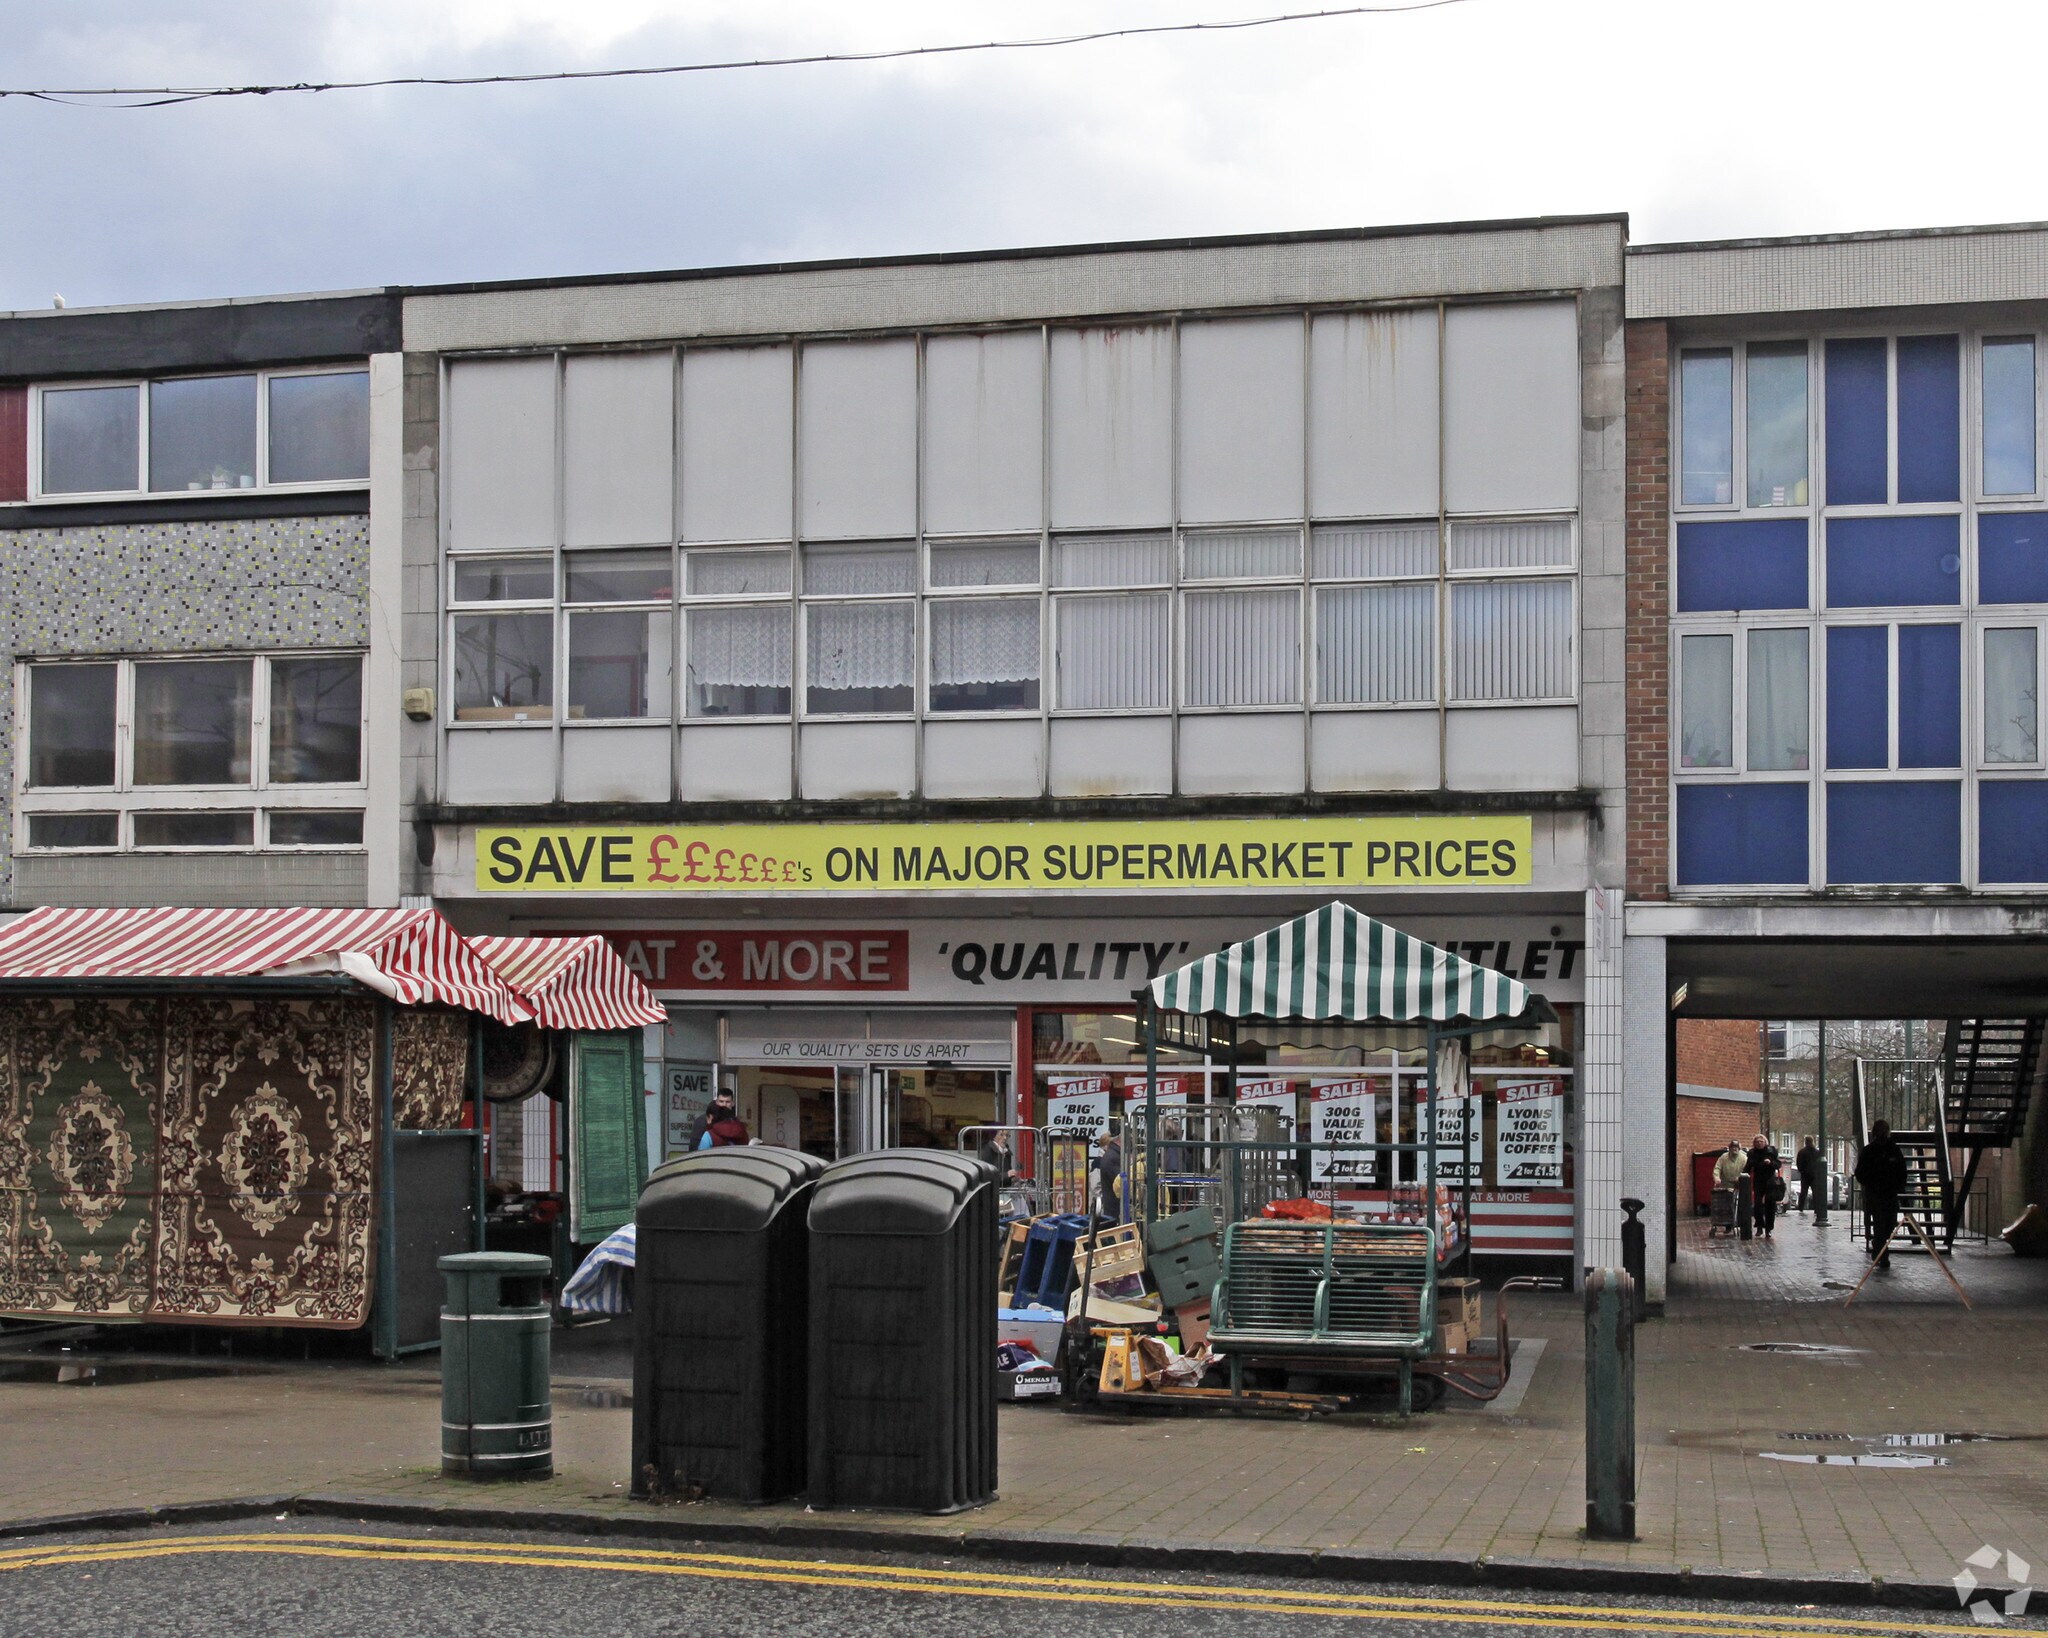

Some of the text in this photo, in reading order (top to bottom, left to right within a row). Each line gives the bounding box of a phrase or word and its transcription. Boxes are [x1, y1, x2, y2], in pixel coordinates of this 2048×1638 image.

[489, 836, 634, 884] SAVE
[825, 846, 879, 882] ON
[893, 844, 1030, 882] MAJOR
[1042, 841, 1354, 880] SUPERMARKET
[1367, 839, 1517, 878] PRICES
[612, 939, 891, 982] AT & MORE
[939, 941, 1190, 985] 'QUALITY'
[762, 1043, 970, 1058] OUR 'QUALITY' SETS US APART
[673, 1074, 708, 1092] SAVE
[1056, 1079, 1101, 1098] SALE!
[1133, 1080, 1178, 1099] SLE!
[1240, 1080, 1287, 1100] SALE!
[1319, 1080, 1367, 1100] SALE!
[1506, 1083, 1554, 1101] SALE!
[1063, 1104, 1095, 1114] 'BIG'
[1325, 1107, 1361, 1117] 300G
[1507, 1108, 1552, 1119] LYONS
[1077, 1116, 1104, 1126] BAG
[1322, 1118, 1365, 1129] VALUE
[1438, 1120, 1461, 1130] 100
[1512, 1120, 1547, 1130] 100G
[1064, 1127, 1097, 1137] ORK
[1324, 1130, 1362, 1140] BACK
[1499, 1132, 1560, 1142] INSTANT
[1504, 1144, 1556, 1154] COFFEE
[1332, 1163, 1373, 1174] 3 for £2
[1436, 1164, 1443, 1175] 2
[1443, 1165, 1453, 1174] for
[1516, 1165, 1561, 1176] 2 for £1.50
[1453, 1192, 1531, 1202] MAT & MORE
